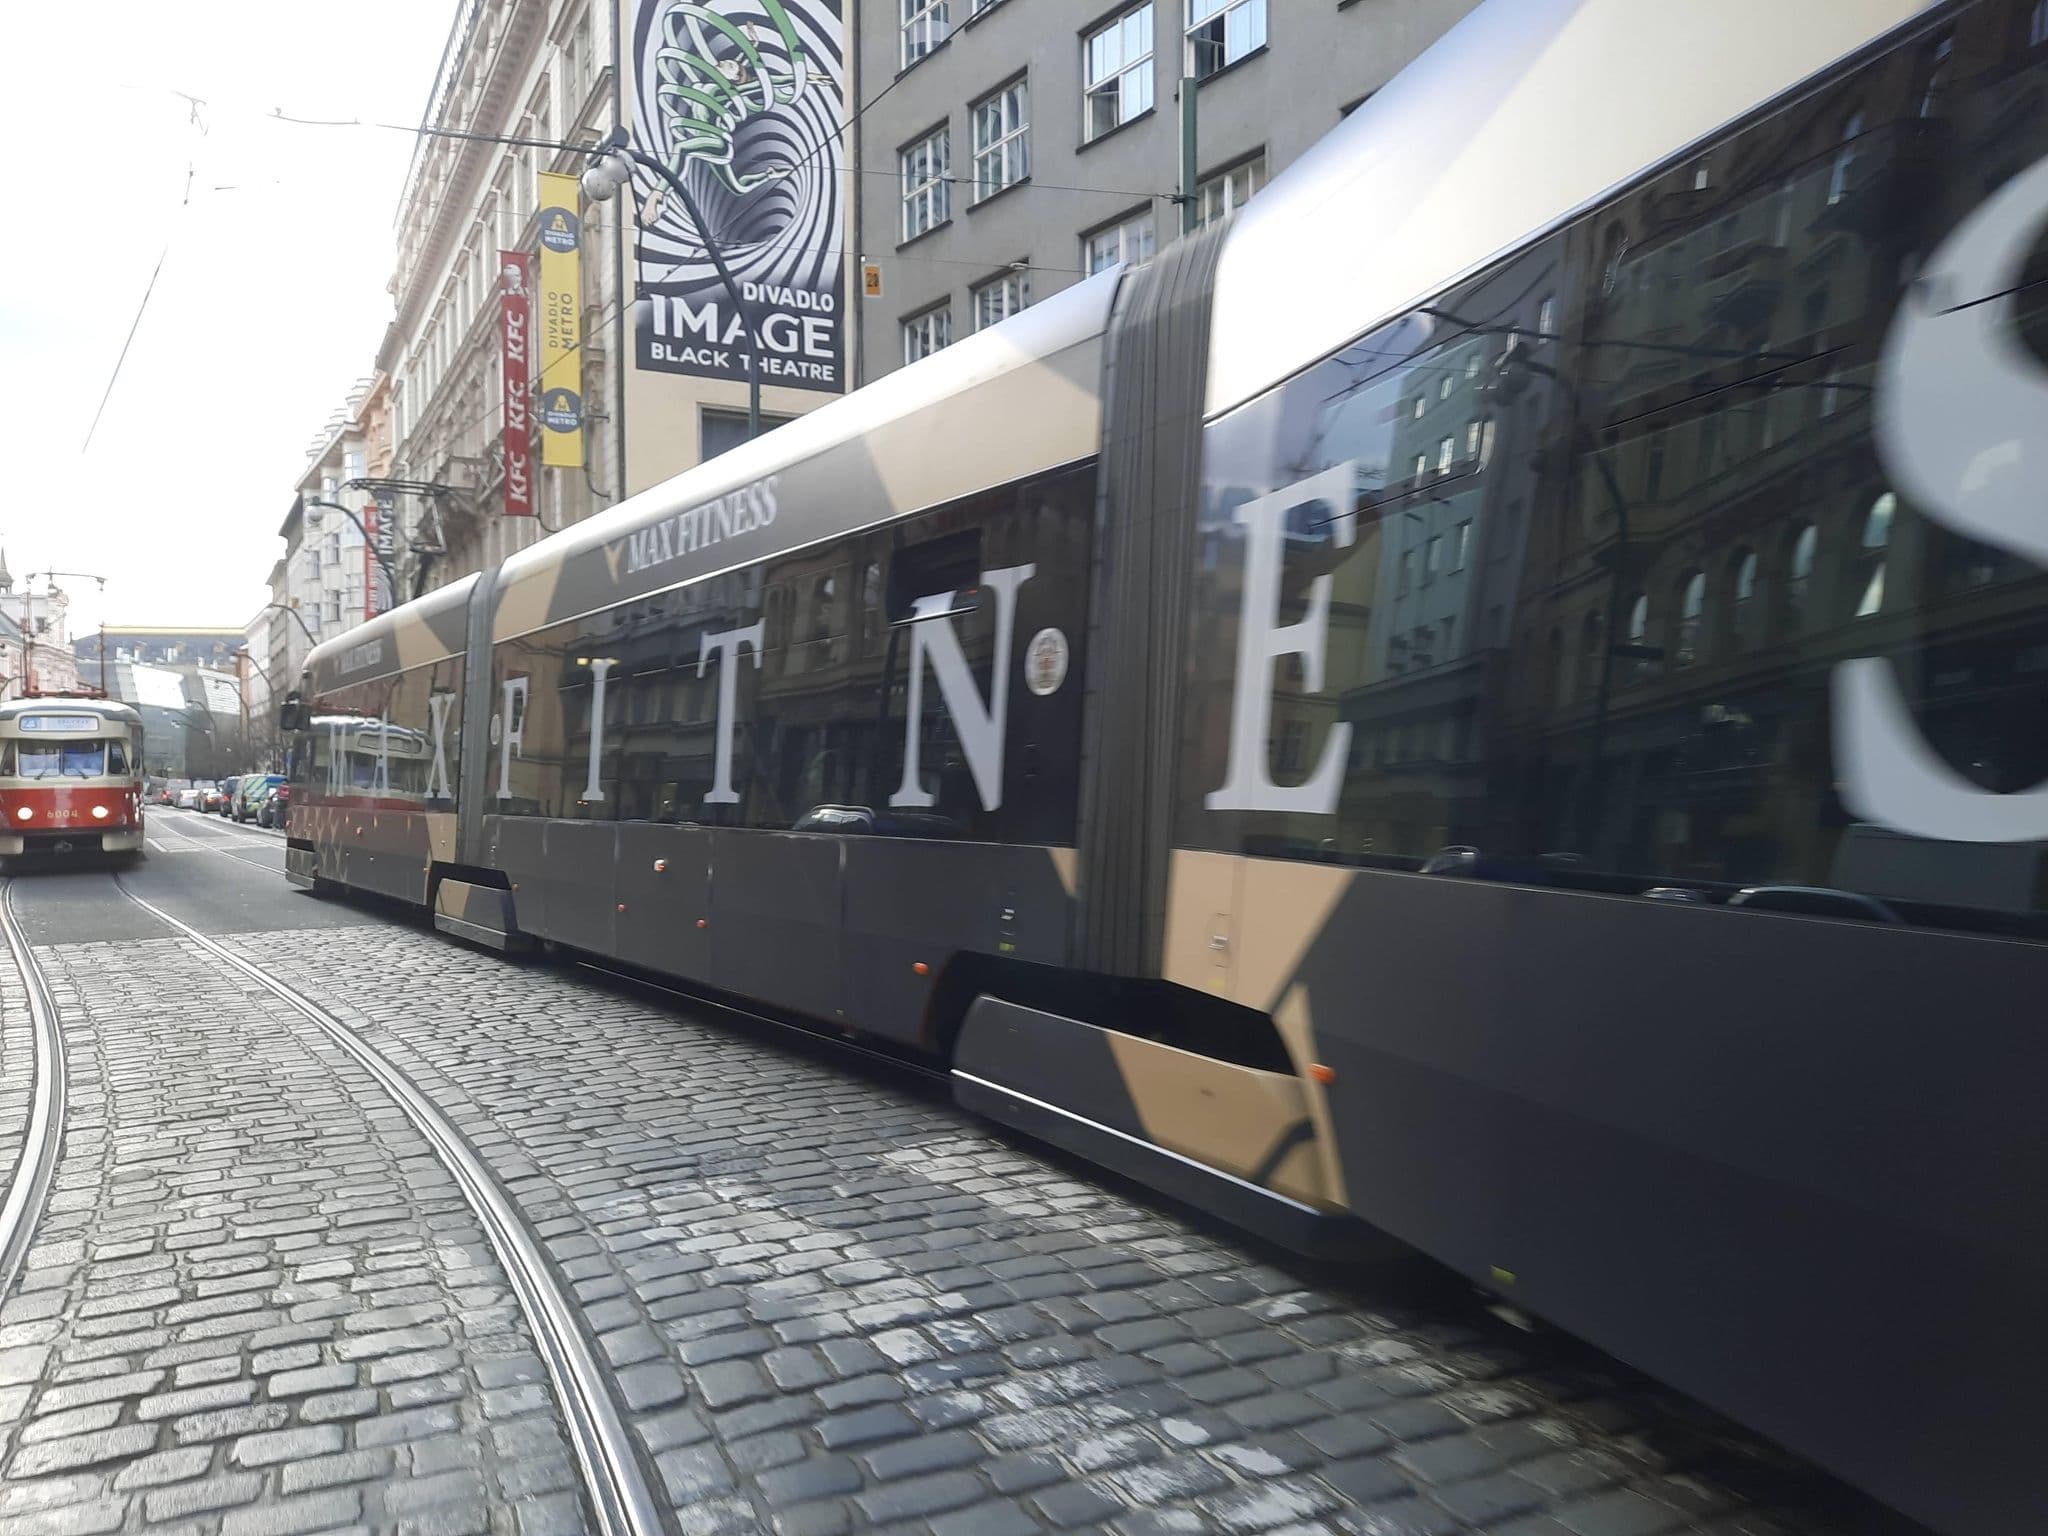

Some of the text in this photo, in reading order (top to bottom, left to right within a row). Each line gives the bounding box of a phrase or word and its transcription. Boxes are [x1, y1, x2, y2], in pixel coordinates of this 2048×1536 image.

[544, 236, 575, 246] METRO
[548, 291, 558, 348] DIVADLO
[561, 293, 573, 349] METRO
[743, 281, 835, 312] DIVADLO
[507, 310, 523, 361] KFC
[650, 293, 834, 358] IMAGE
[650, 342, 835, 381] BLACK THEATRE
[508, 379, 525, 433] KFC
[510, 451, 528, 504] KFC
[378, 500, 393, 554] IMAGE
[627, 475, 778, 573] MAX FITNESS
[47, 809, 78, 818] 6004
